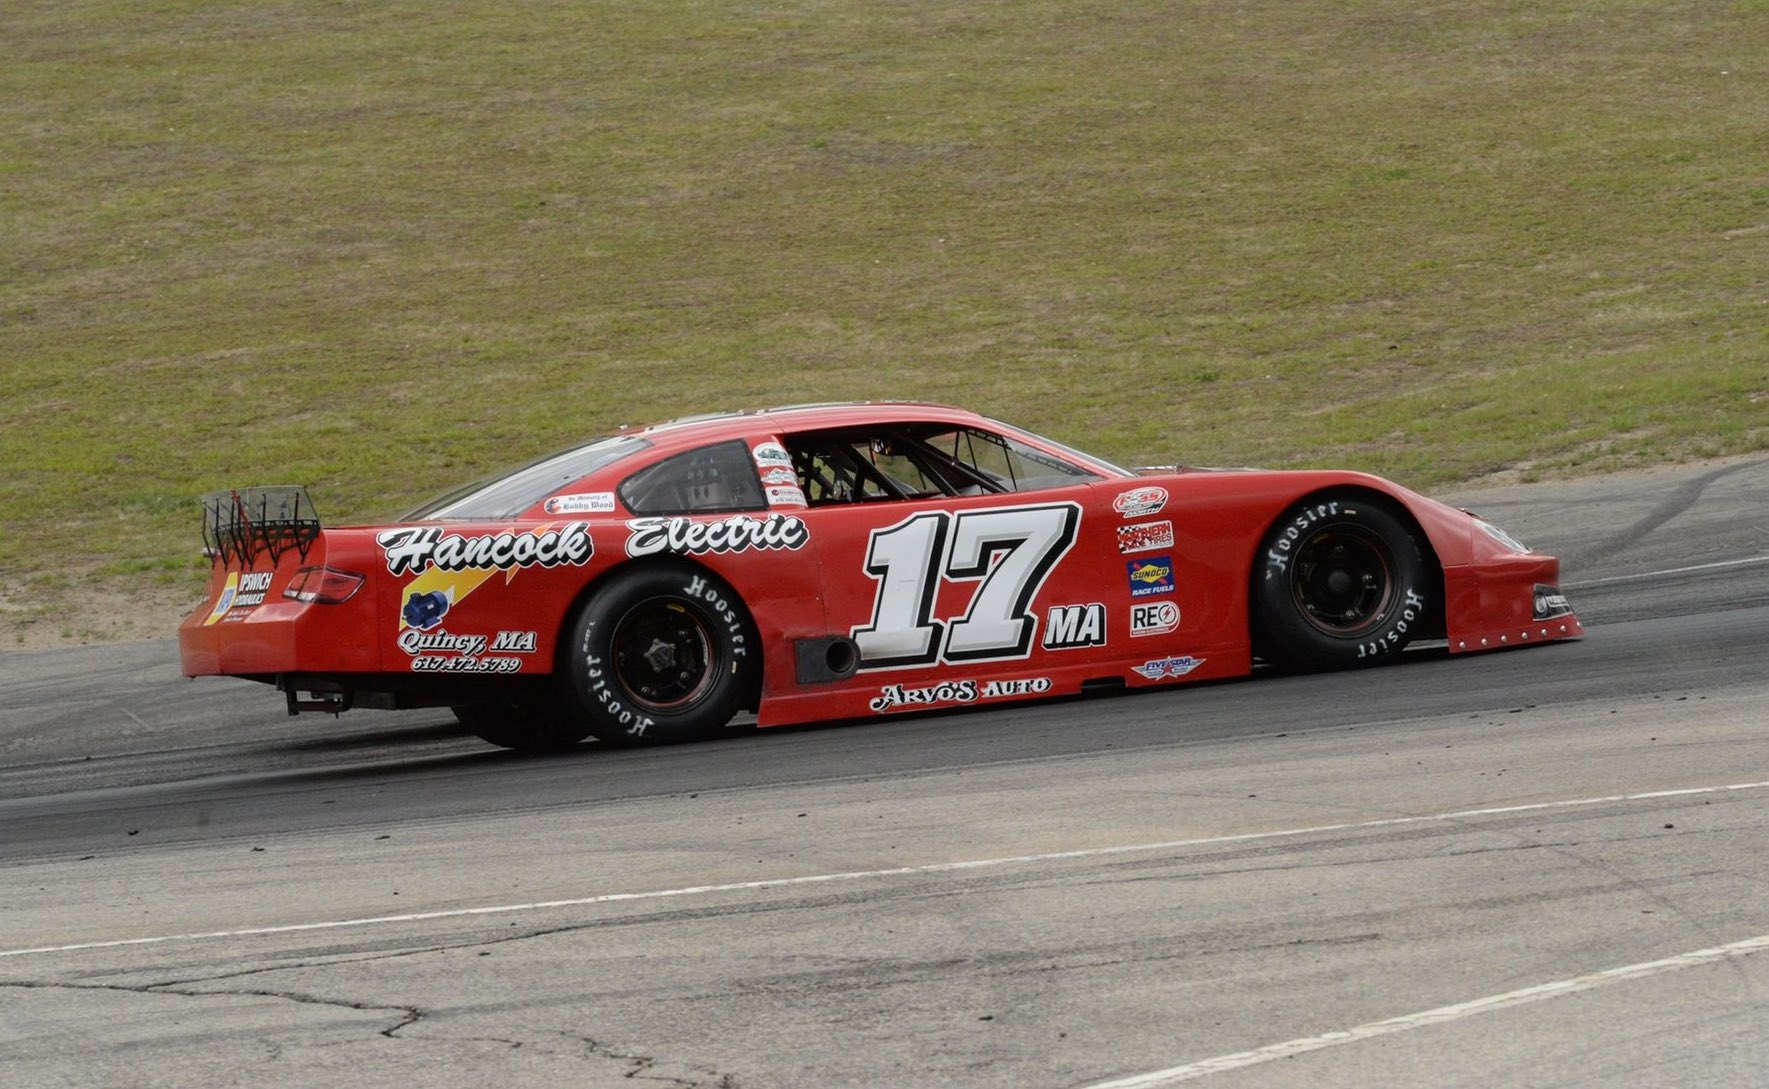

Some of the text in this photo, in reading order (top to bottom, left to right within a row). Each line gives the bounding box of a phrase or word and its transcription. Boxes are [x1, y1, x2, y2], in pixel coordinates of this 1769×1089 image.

[376, 513, 810, 577] Hancock Electric
[1117, 523, 1171, 545] NORTHERN
[1268, 501, 1338, 574] Hoosier
[238, 572, 274, 592] IPSWICH
[1132, 567, 1168, 580] SUNOCO
[850, 501, 1083, 673] 17
[1132, 584, 1175, 596] RACE FUELS
[683, 575, 747, 657] Hoosier
[1041, 603, 1107, 650] MA
[1357, 587, 1424, 659] Hoosier
[397, 630, 537, 656] Quincy, MA
[411, 656, 522, 674] 617.472.5789
[1170, 657, 1192, 667] STAR
[586, 654, 655, 737] Hoosier
[981, 678, 1053, 698] AUTO
